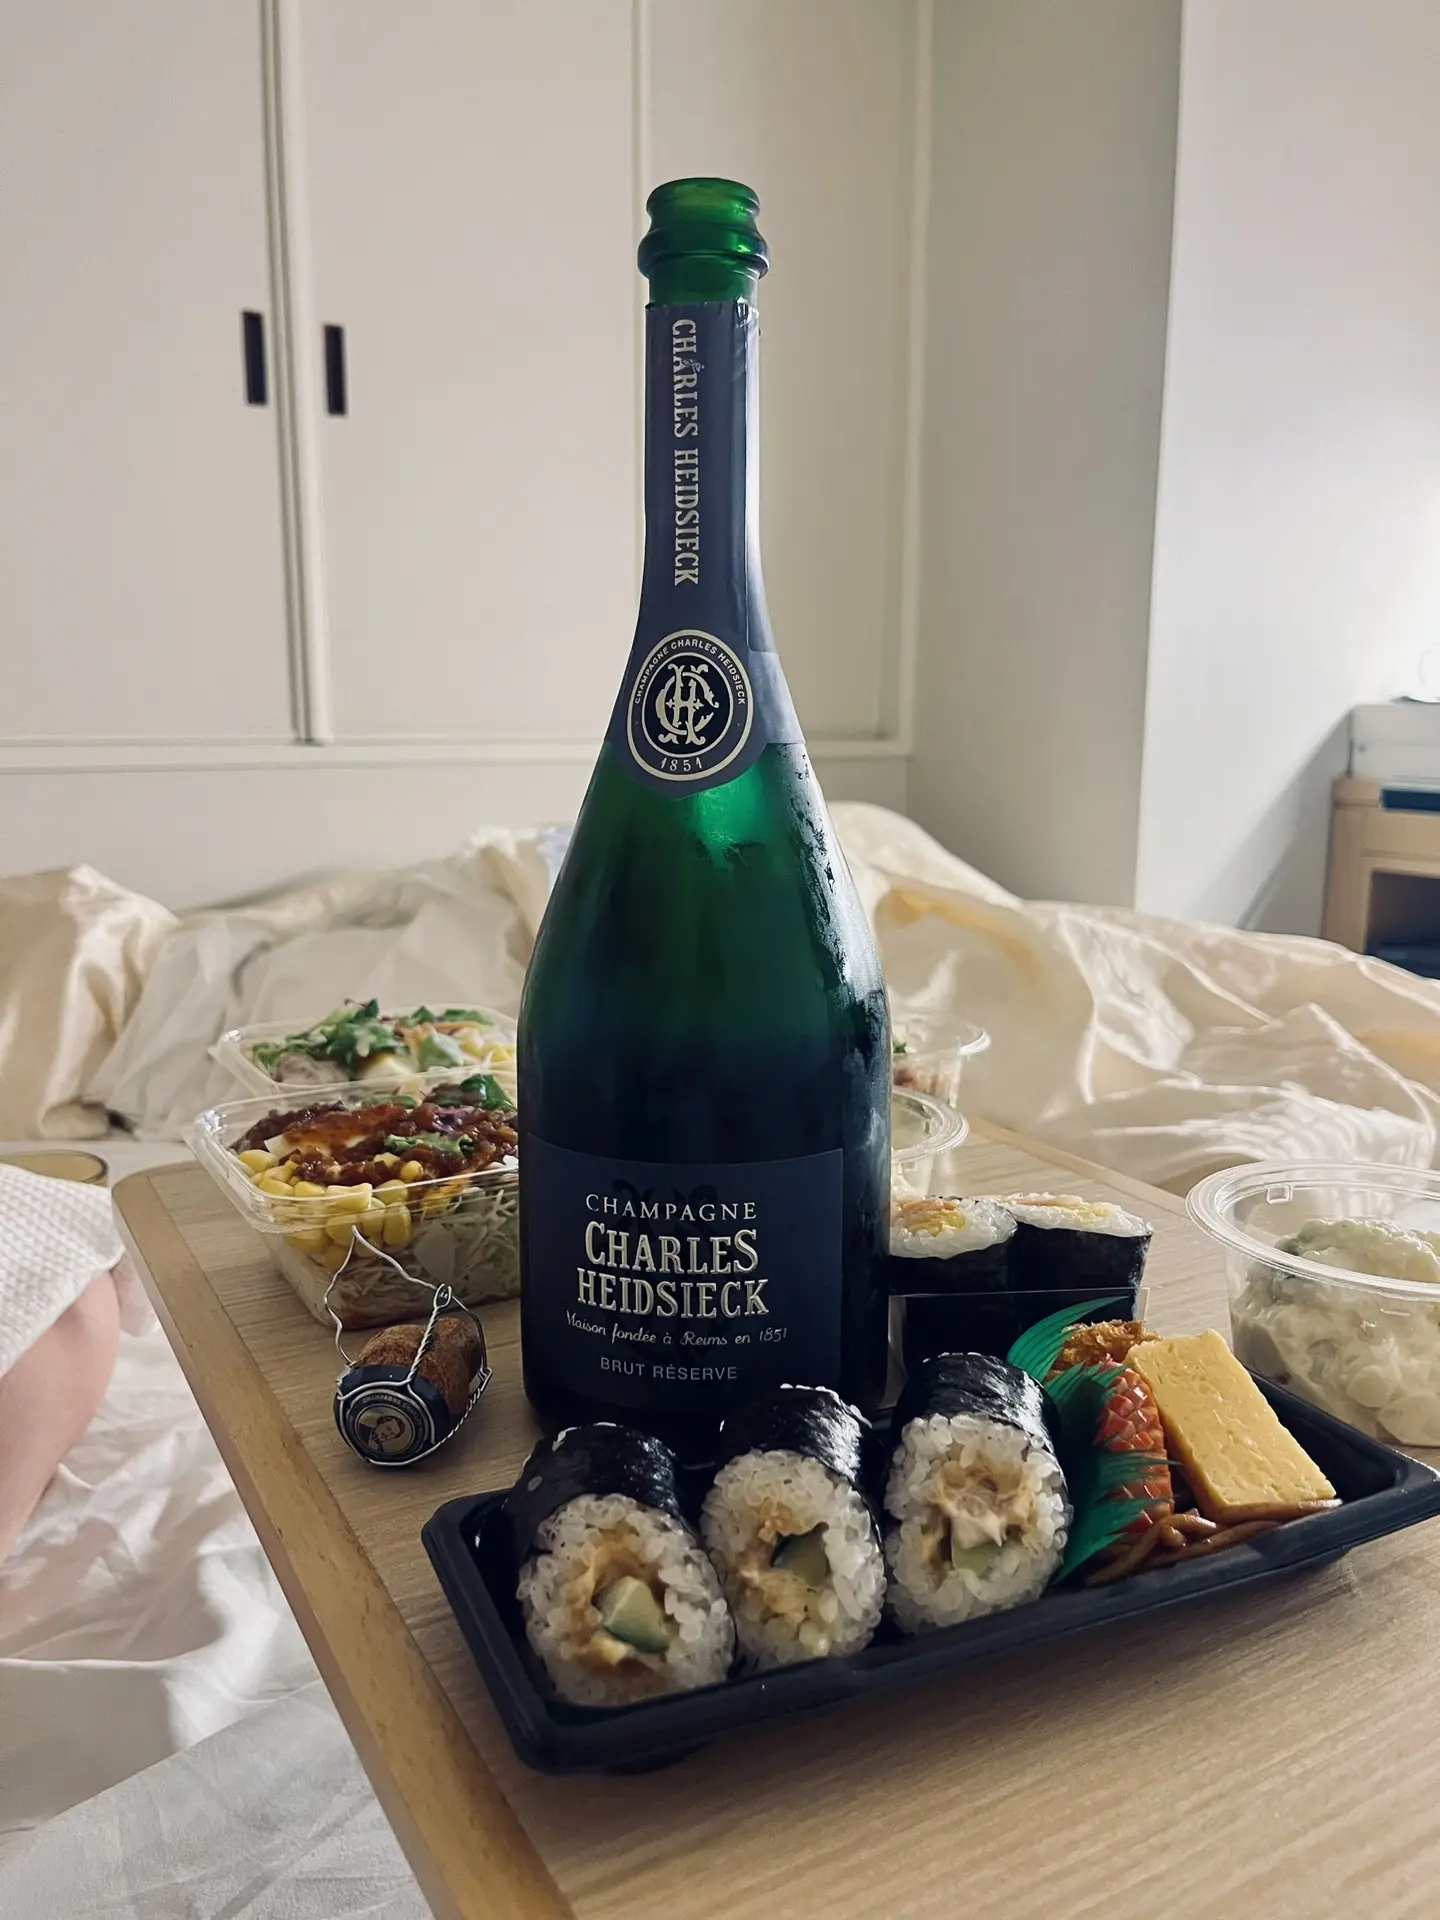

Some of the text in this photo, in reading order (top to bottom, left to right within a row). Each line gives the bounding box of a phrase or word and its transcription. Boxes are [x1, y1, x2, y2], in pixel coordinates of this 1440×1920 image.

[672, 319, 700, 587] CHARLES HEIDSIECK
[635, 638, 746, 705] CHAMPAGNE CHARLES HEIDSIECK
[660, 757, 703, 772] 1851
[585, 1193, 758, 1222] CHAMPAGNE
[585, 1221, 759, 1274] CHARLES
[576, 1267, 769, 1319] HEIDSIECK
[565, 1309, 788, 1346] Maison fondée à Reims en 1851
[600, 1356, 738, 1381] BRUT RÉSERVE
